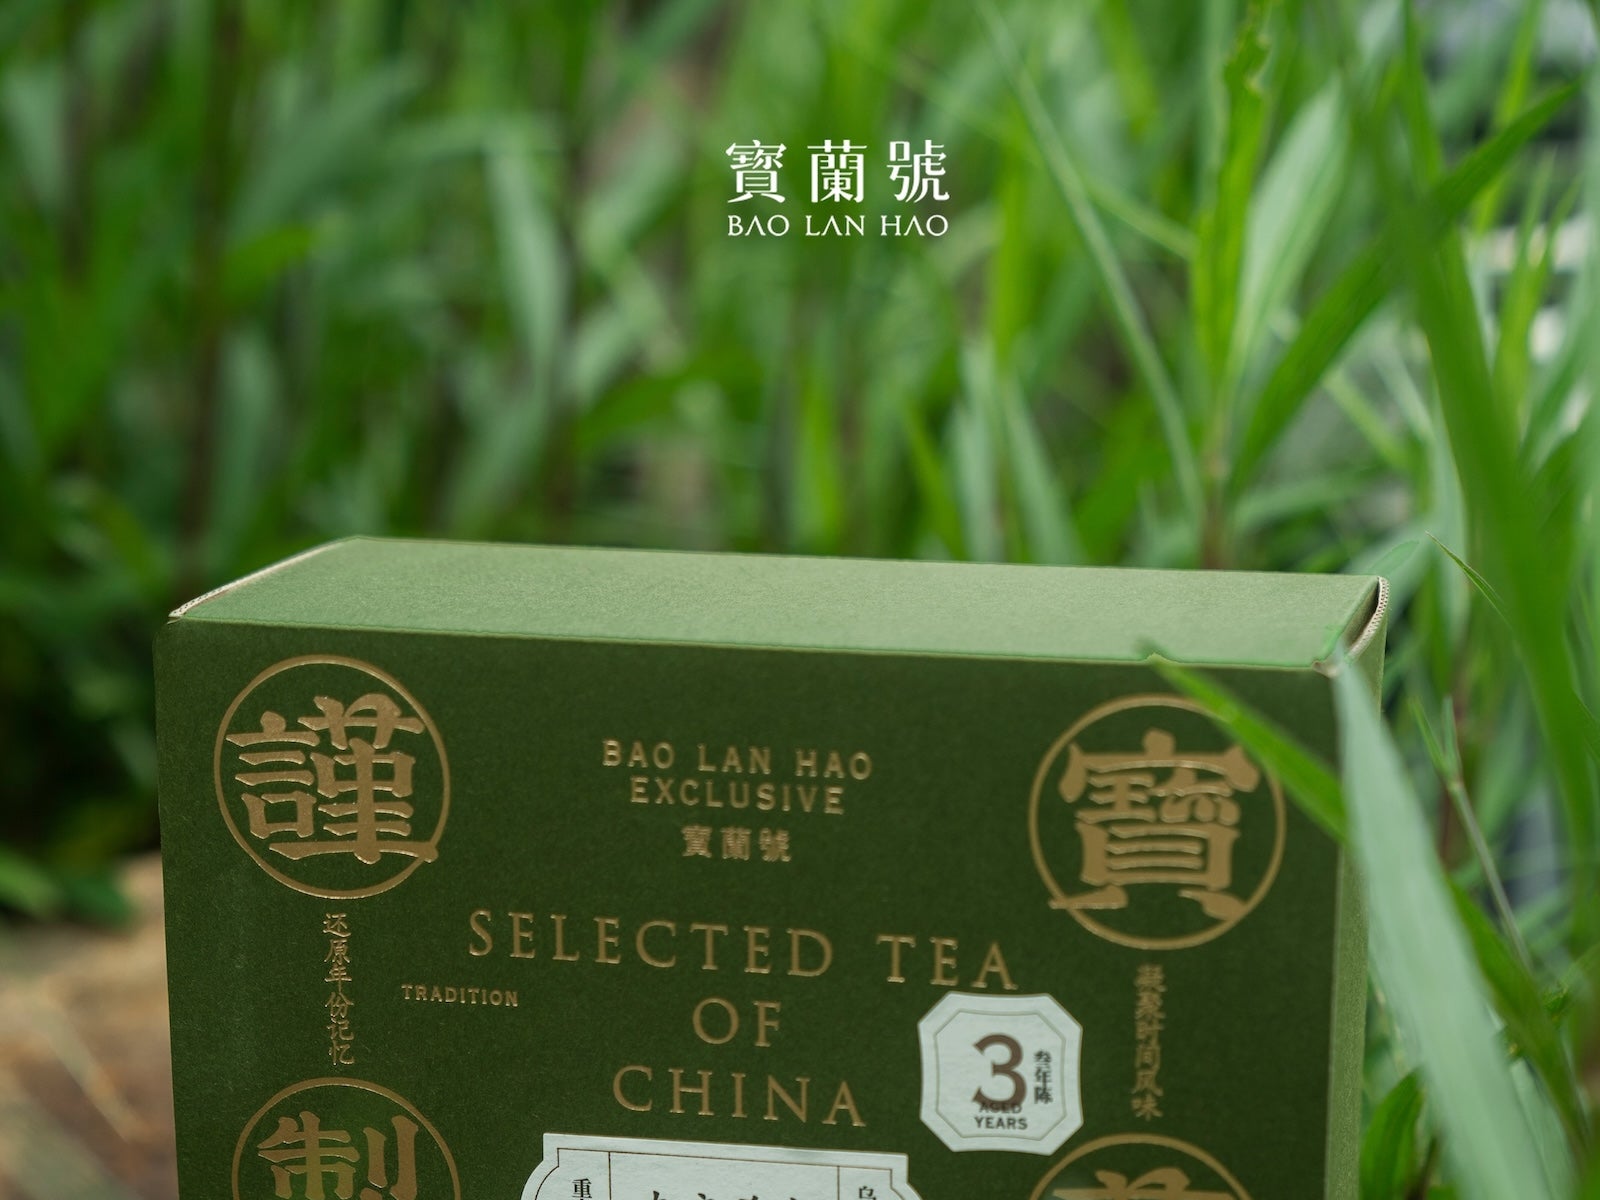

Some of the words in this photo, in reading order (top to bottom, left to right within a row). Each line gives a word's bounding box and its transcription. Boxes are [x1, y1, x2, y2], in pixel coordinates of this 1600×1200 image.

[225, 692, 439, 865] 謹
[602, 738, 675, 769] BAO
[697, 743, 772, 775] LAN
[795, 748, 873, 781] HAO
[629, 775, 845, 816] EXCLUSIVE
[468, 908, 834, 978] SELECTED
[877, 933, 1018, 991] TEA
[322, 911, 356, 1067] 还原年份记忆
[400, 983, 519, 1008] TRADITION
[692, 997, 782, 1048] OF
[612, 1064, 867, 1128] CHINA
[972, 1032, 1028, 1111] 3
[1033, 1048, 1054, 1105] 叁年陈
[973, 1116, 1029, 1130] YEARS
